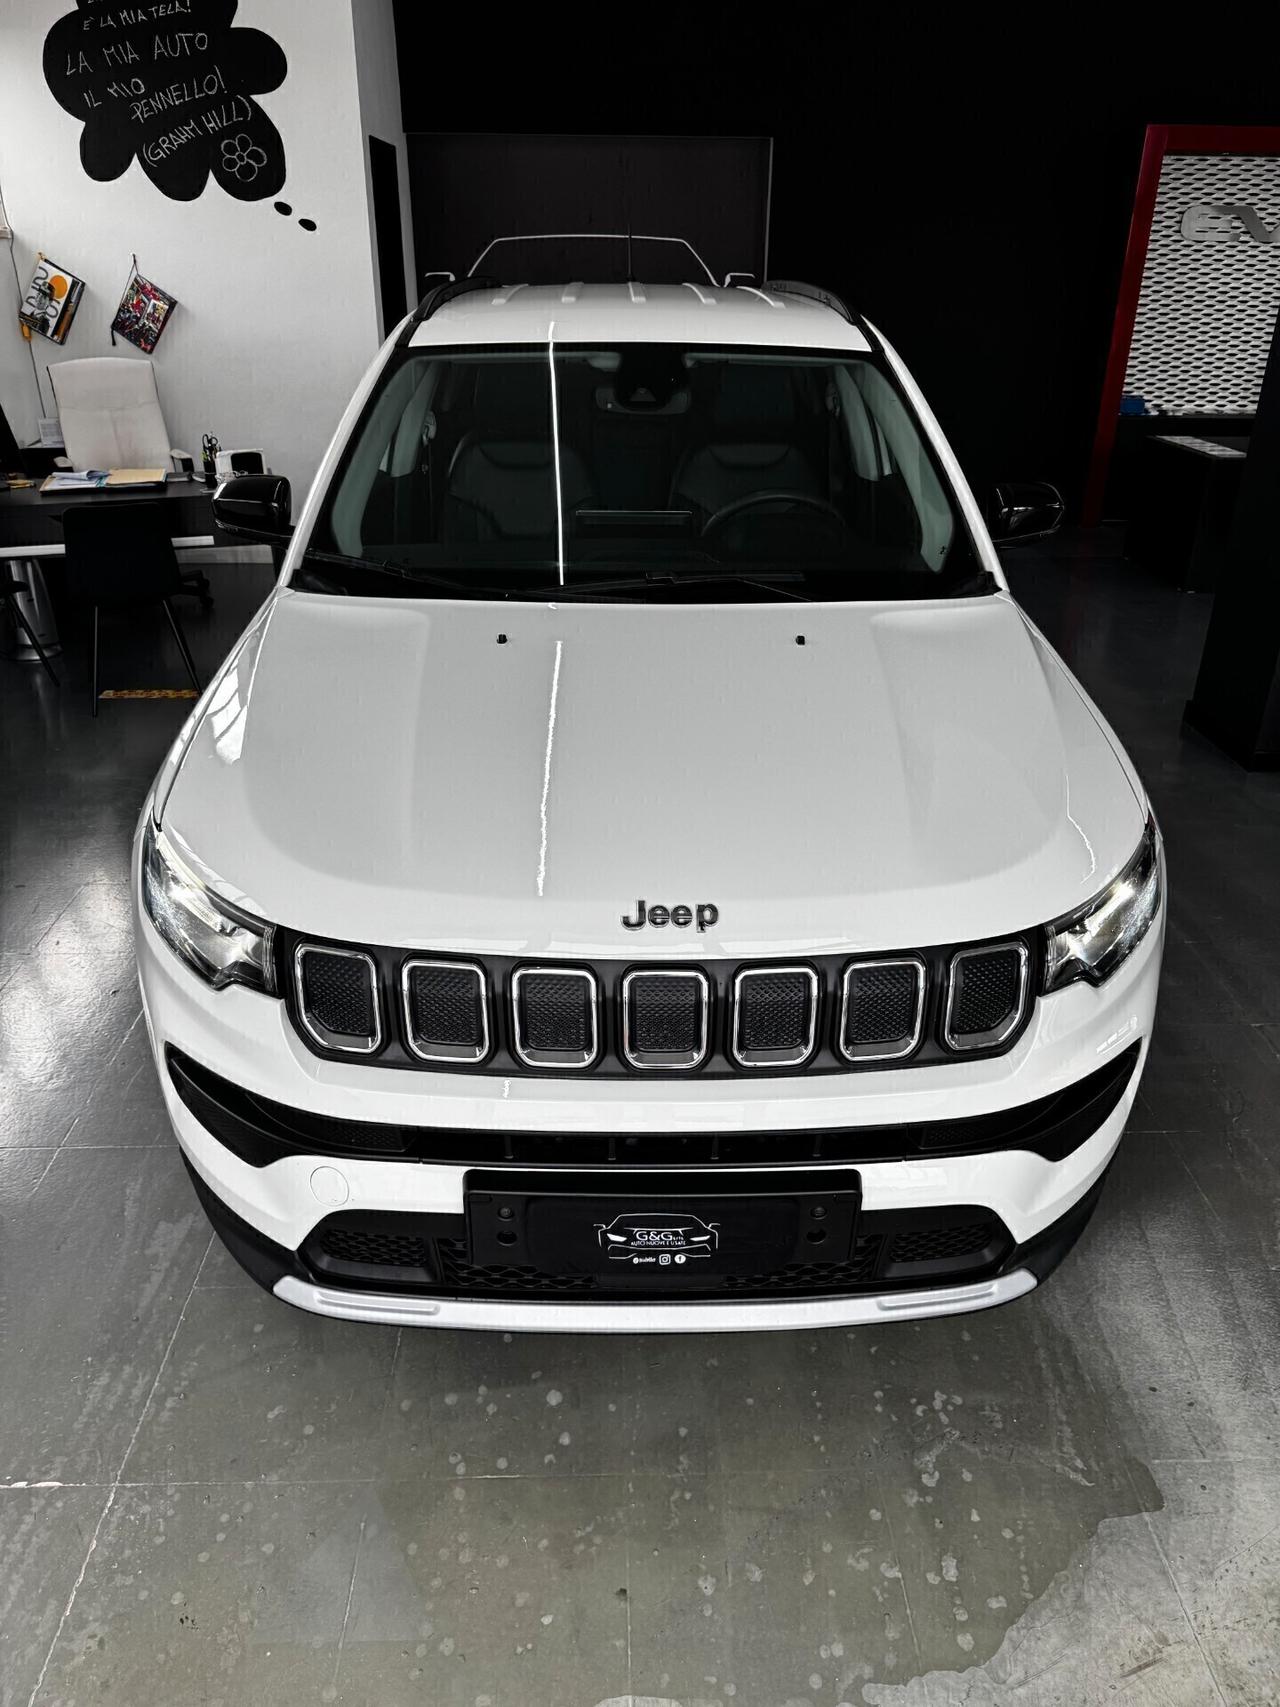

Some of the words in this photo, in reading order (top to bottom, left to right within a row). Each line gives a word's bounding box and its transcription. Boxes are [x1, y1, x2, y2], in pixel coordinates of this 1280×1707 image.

[99, 15, 117, 28] LA
[119, 8, 148, 26] MIA
[148, 0, 192, 20] TELA!
[66, 51, 93, 75] LA
[102, 41, 140, 66] MIA
[154, 32, 208, 60] AUTO
[83, 90, 102, 108] IL
[107, 78, 146, 99] MIO
[130, 65, 229, 123] PENNELLO!
[201, 95, 251, 134] HILL)
[620, 899, 720, 934] Jeep
